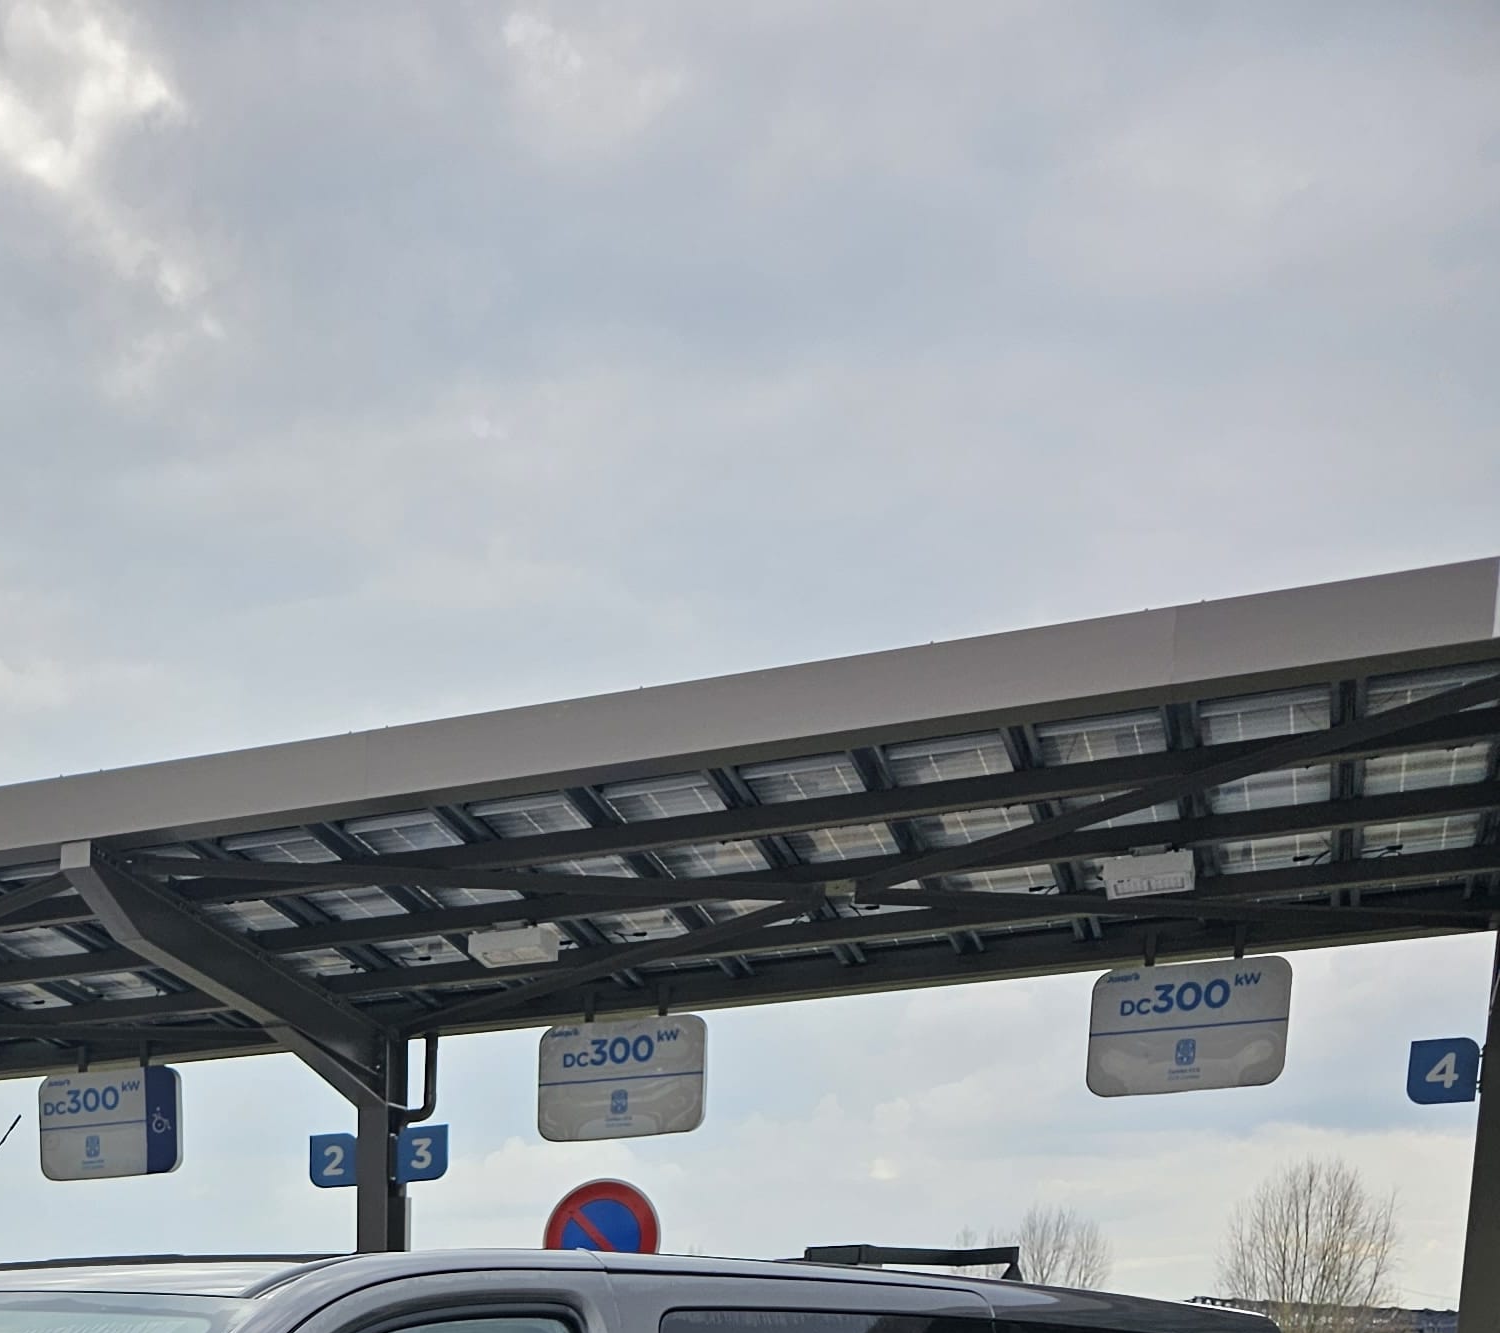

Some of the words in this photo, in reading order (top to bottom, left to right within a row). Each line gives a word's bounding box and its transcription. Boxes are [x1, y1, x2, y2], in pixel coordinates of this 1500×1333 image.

[1425, 1052, 1459, 1088] 4
[323, 1145, 344, 1176] 2
[410, 1137, 432, 1169] 3
